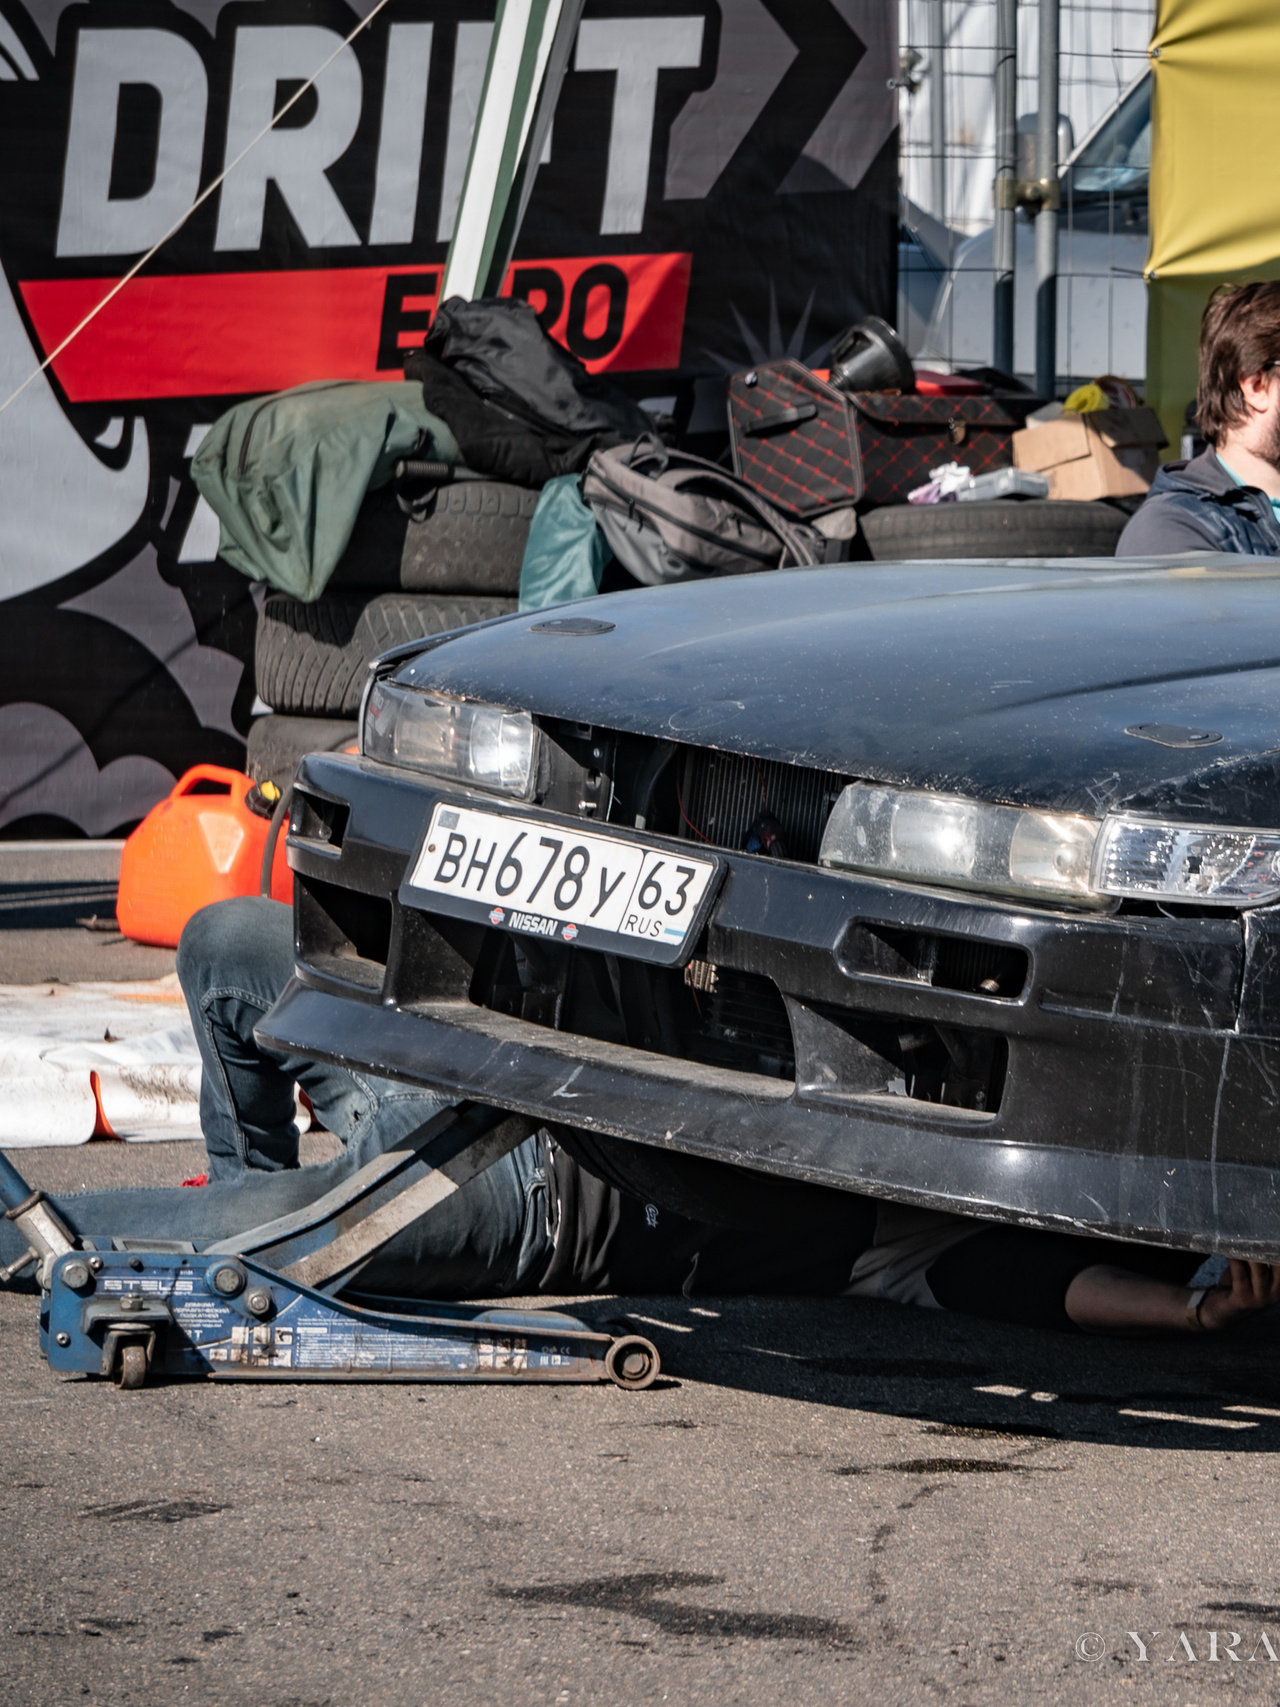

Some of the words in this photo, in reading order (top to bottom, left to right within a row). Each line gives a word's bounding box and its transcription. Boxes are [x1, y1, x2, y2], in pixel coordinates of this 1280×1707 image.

[376, 262, 629, 372] EPO
[637, 861, 696, 916] 63
[508, 911, 559, 937] NISSAN
[624, 914, 663, 938] RUS
[104, 1279, 194, 1292] STELS
